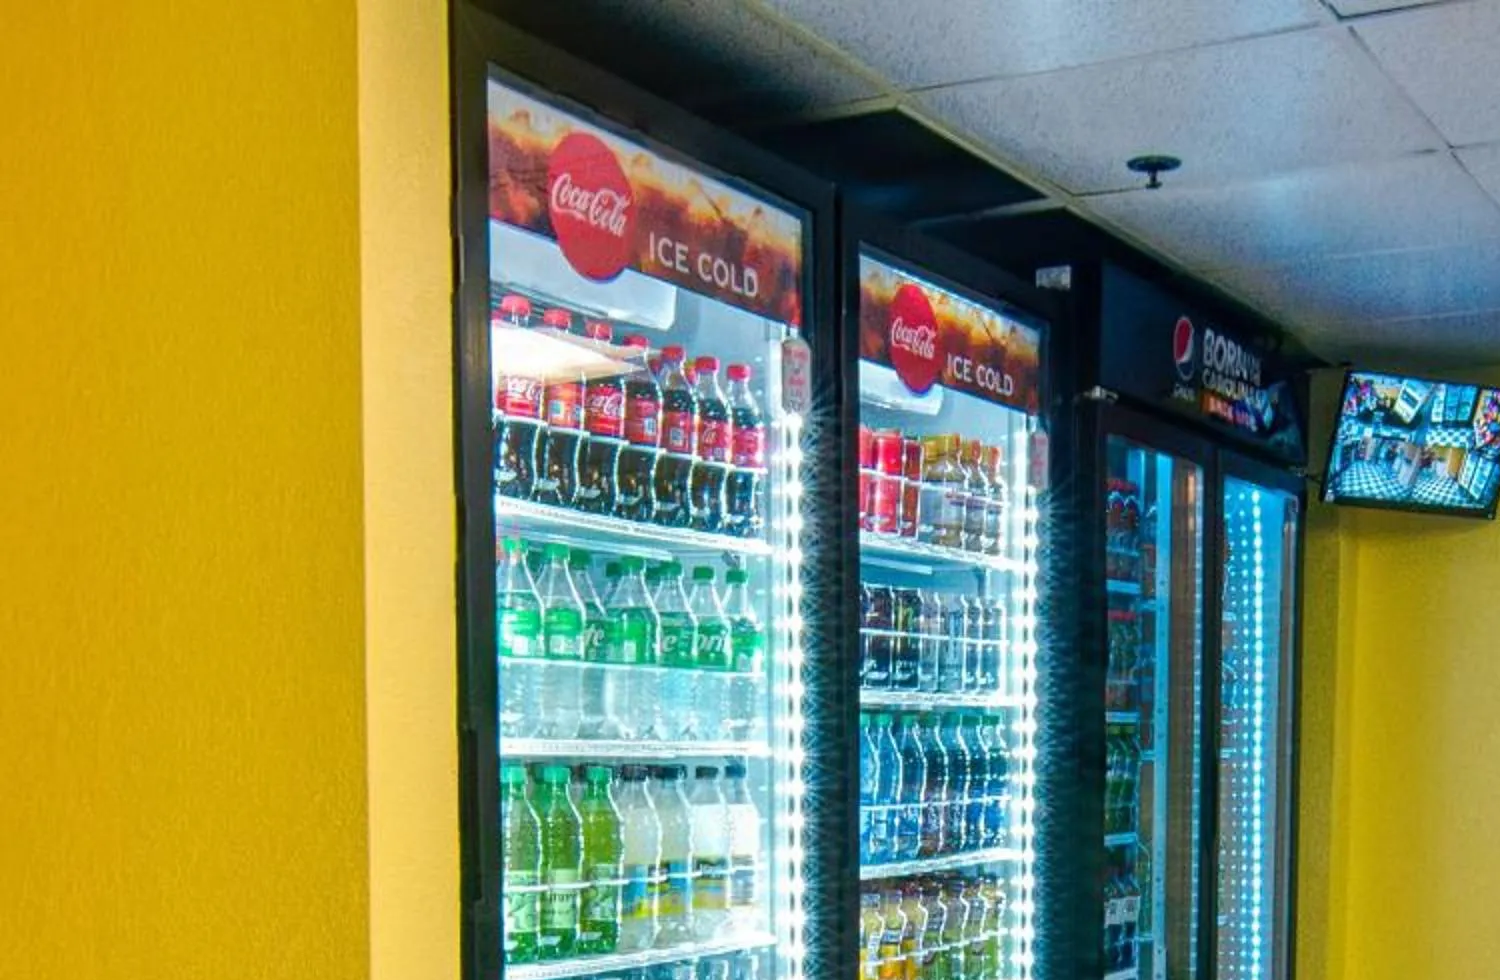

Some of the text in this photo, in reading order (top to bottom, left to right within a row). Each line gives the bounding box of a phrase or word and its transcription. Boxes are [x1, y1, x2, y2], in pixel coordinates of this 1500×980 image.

[552, 173, 630, 237] Coca-Cola
[649, 231, 759, 297] ICE COLD
[947, 352, 1014, 396] ICE COLD
